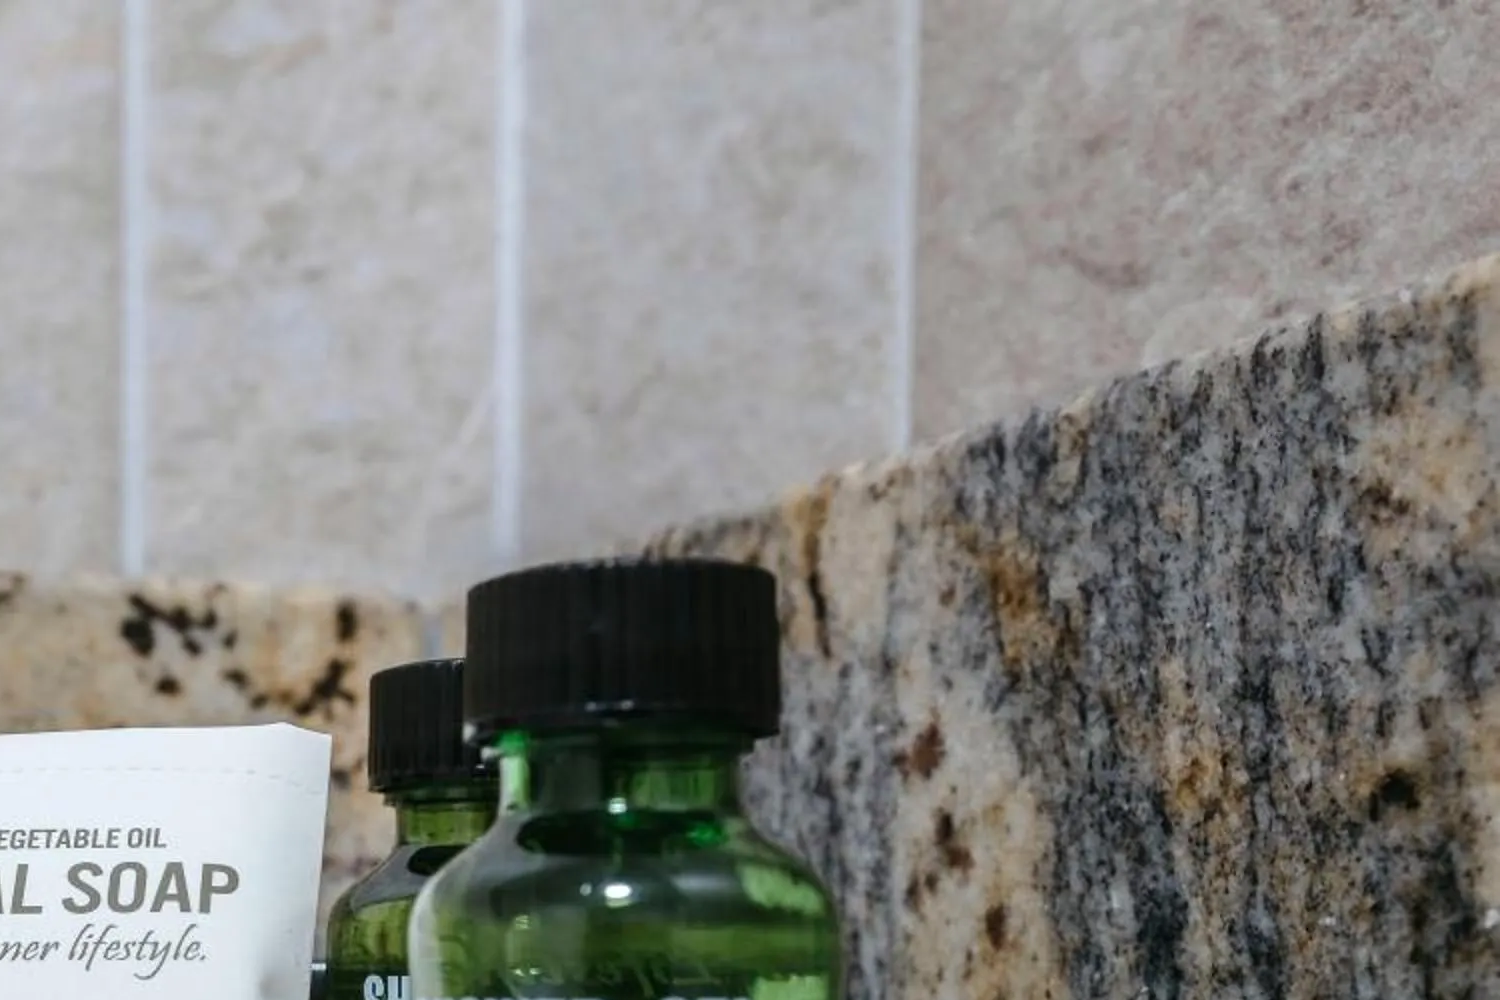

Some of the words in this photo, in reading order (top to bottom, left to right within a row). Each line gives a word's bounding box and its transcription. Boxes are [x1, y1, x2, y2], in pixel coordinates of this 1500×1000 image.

[127, 827, 167, 849] OIL
[61, 860, 240, 915] SOAP
[68, 923, 207, 981] lifestyle.
